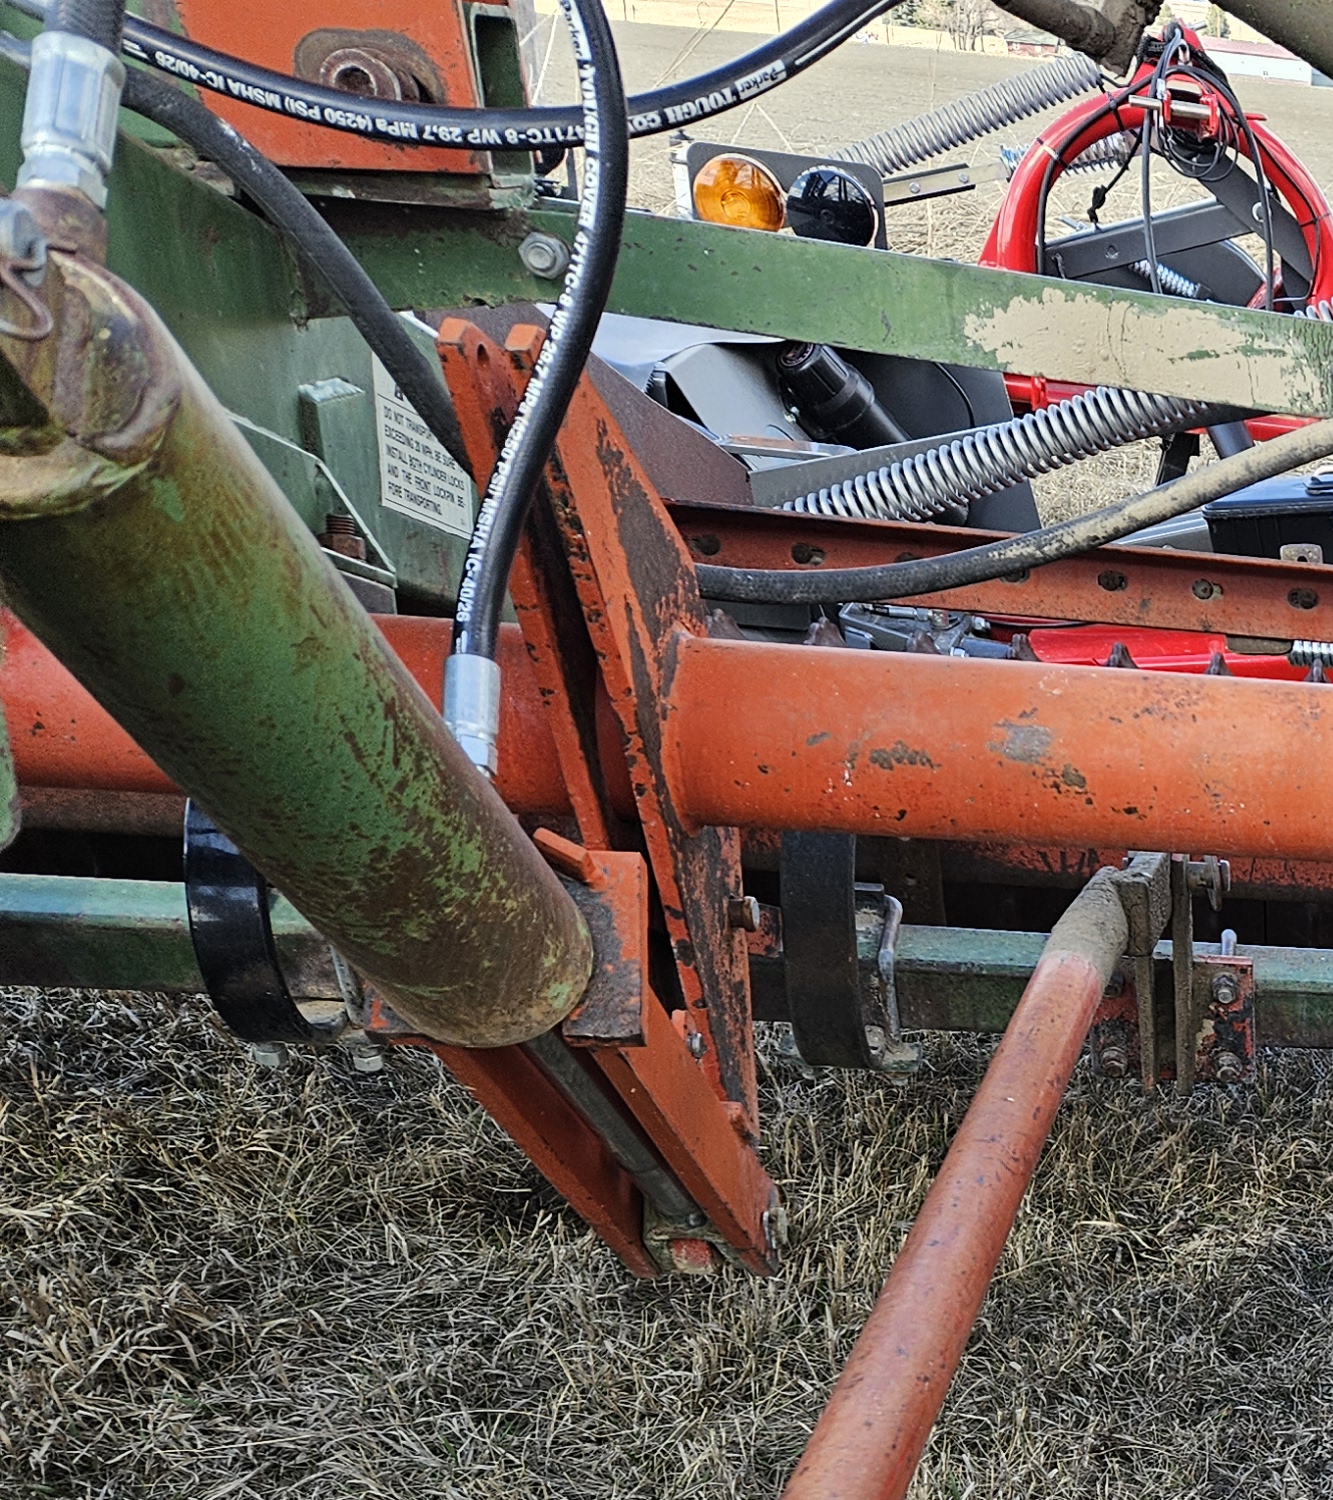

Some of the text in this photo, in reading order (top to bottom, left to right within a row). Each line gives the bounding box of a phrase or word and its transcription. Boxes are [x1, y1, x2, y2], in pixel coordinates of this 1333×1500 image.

[155, 50, 226, 89] IC-40/26
[228, 81, 282, 110] MSHA
[284, 96, 321, 121] PSI)
[664, 87, 737, 124] TOUGH
[324, 106, 374, 132] (4250
[375, 118, 417, 139] MPa
[628, 110, 661, 133] COV
[466, 131, 502, 145] WP
[578, 156, 600, 231] COVER
[559, 231, 589, 307] 471TC-8
[549, 310, 570, 341] WP
[518, 377, 543, 414] MPa
[383, 405, 392, 420] DO
[393, 410, 404, 426] NOT
[386, 444, 407, 464] INSTALL
[409, 454, 422, 471] BOTH
[423, 462, 446, 482] CYLINDER
[448, 474, 464, 491] LOCKS
[434, 450, 441, 462] BE
[387, 462, 398, 478] AND
[401, 469, 412, 484] THE
[414, 475, 431, 493] FRONT
[388, 481, 402, 498] FORE
[470, 497, 499, 549] MSHA
[456, 550, 483, 623] IC-40/26
